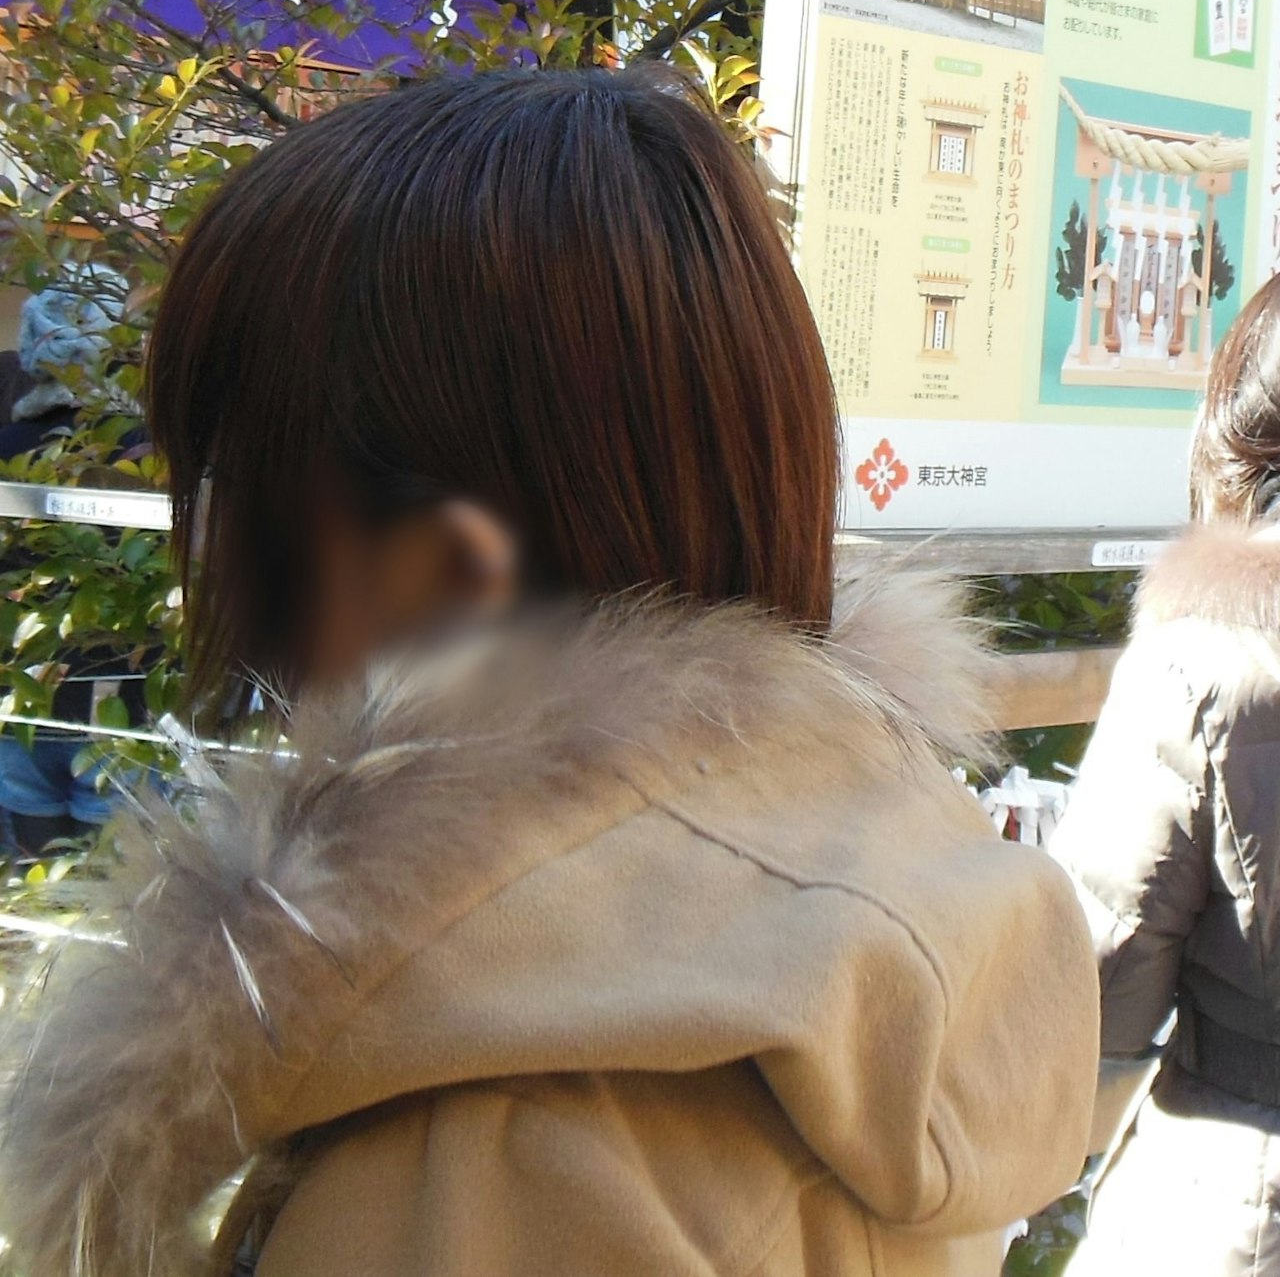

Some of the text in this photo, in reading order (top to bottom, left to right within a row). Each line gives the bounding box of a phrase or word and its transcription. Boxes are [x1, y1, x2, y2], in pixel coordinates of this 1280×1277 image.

[917, 465, 988, 487] 東京大神宮
